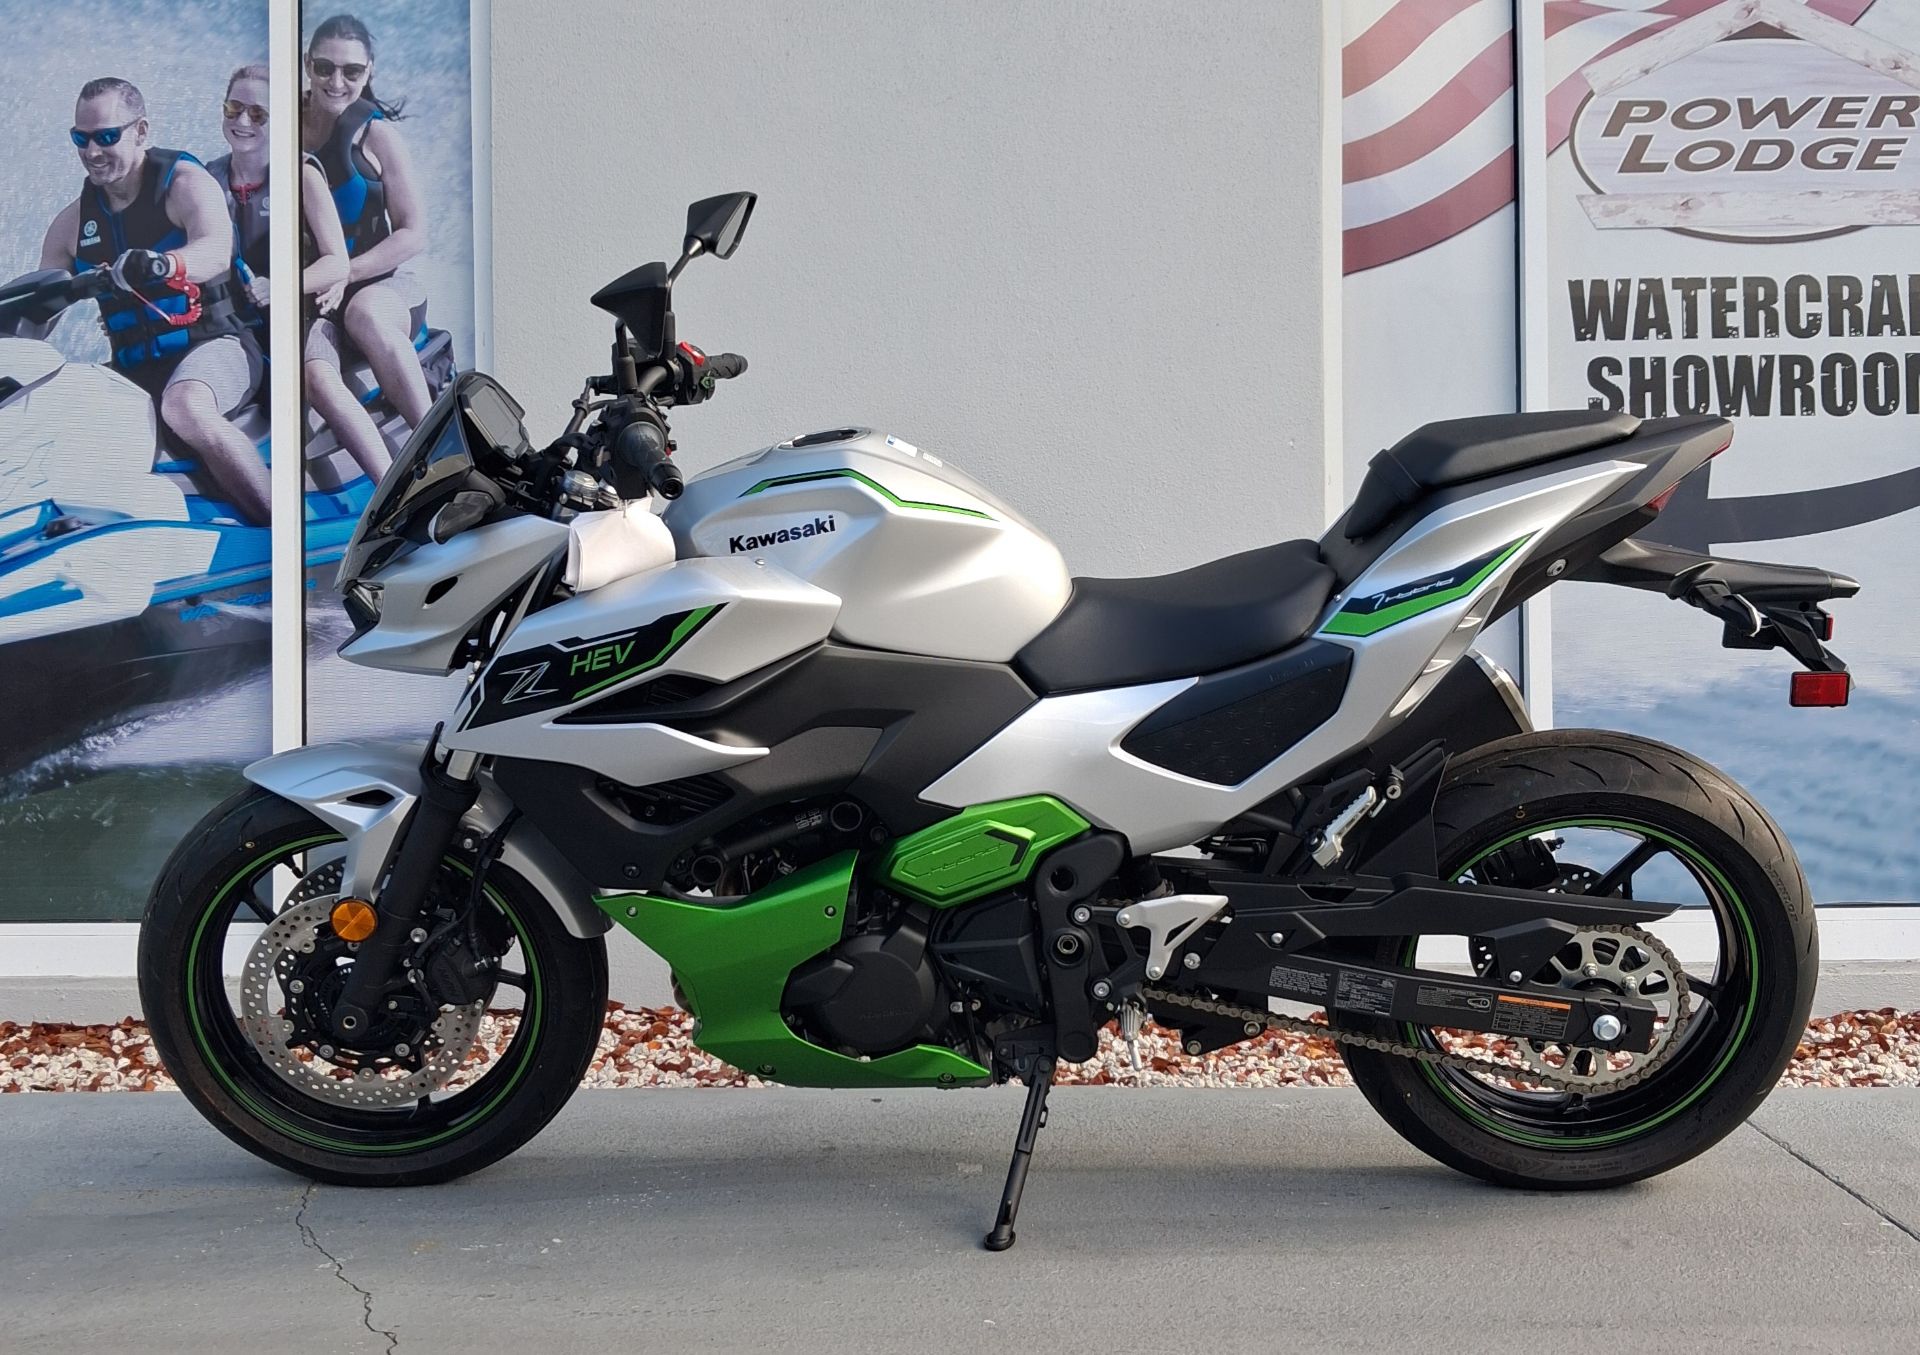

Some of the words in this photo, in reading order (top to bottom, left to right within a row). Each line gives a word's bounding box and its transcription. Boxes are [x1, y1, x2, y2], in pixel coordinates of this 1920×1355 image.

[1601, 95, 1920, 138] POWER
[1617, 134, 1908, 174] LODGE
[729, 514, 836, 554] Kawasaki
[570, 640, 636, 676] HEV
[498, 660, 560, 705] Z
